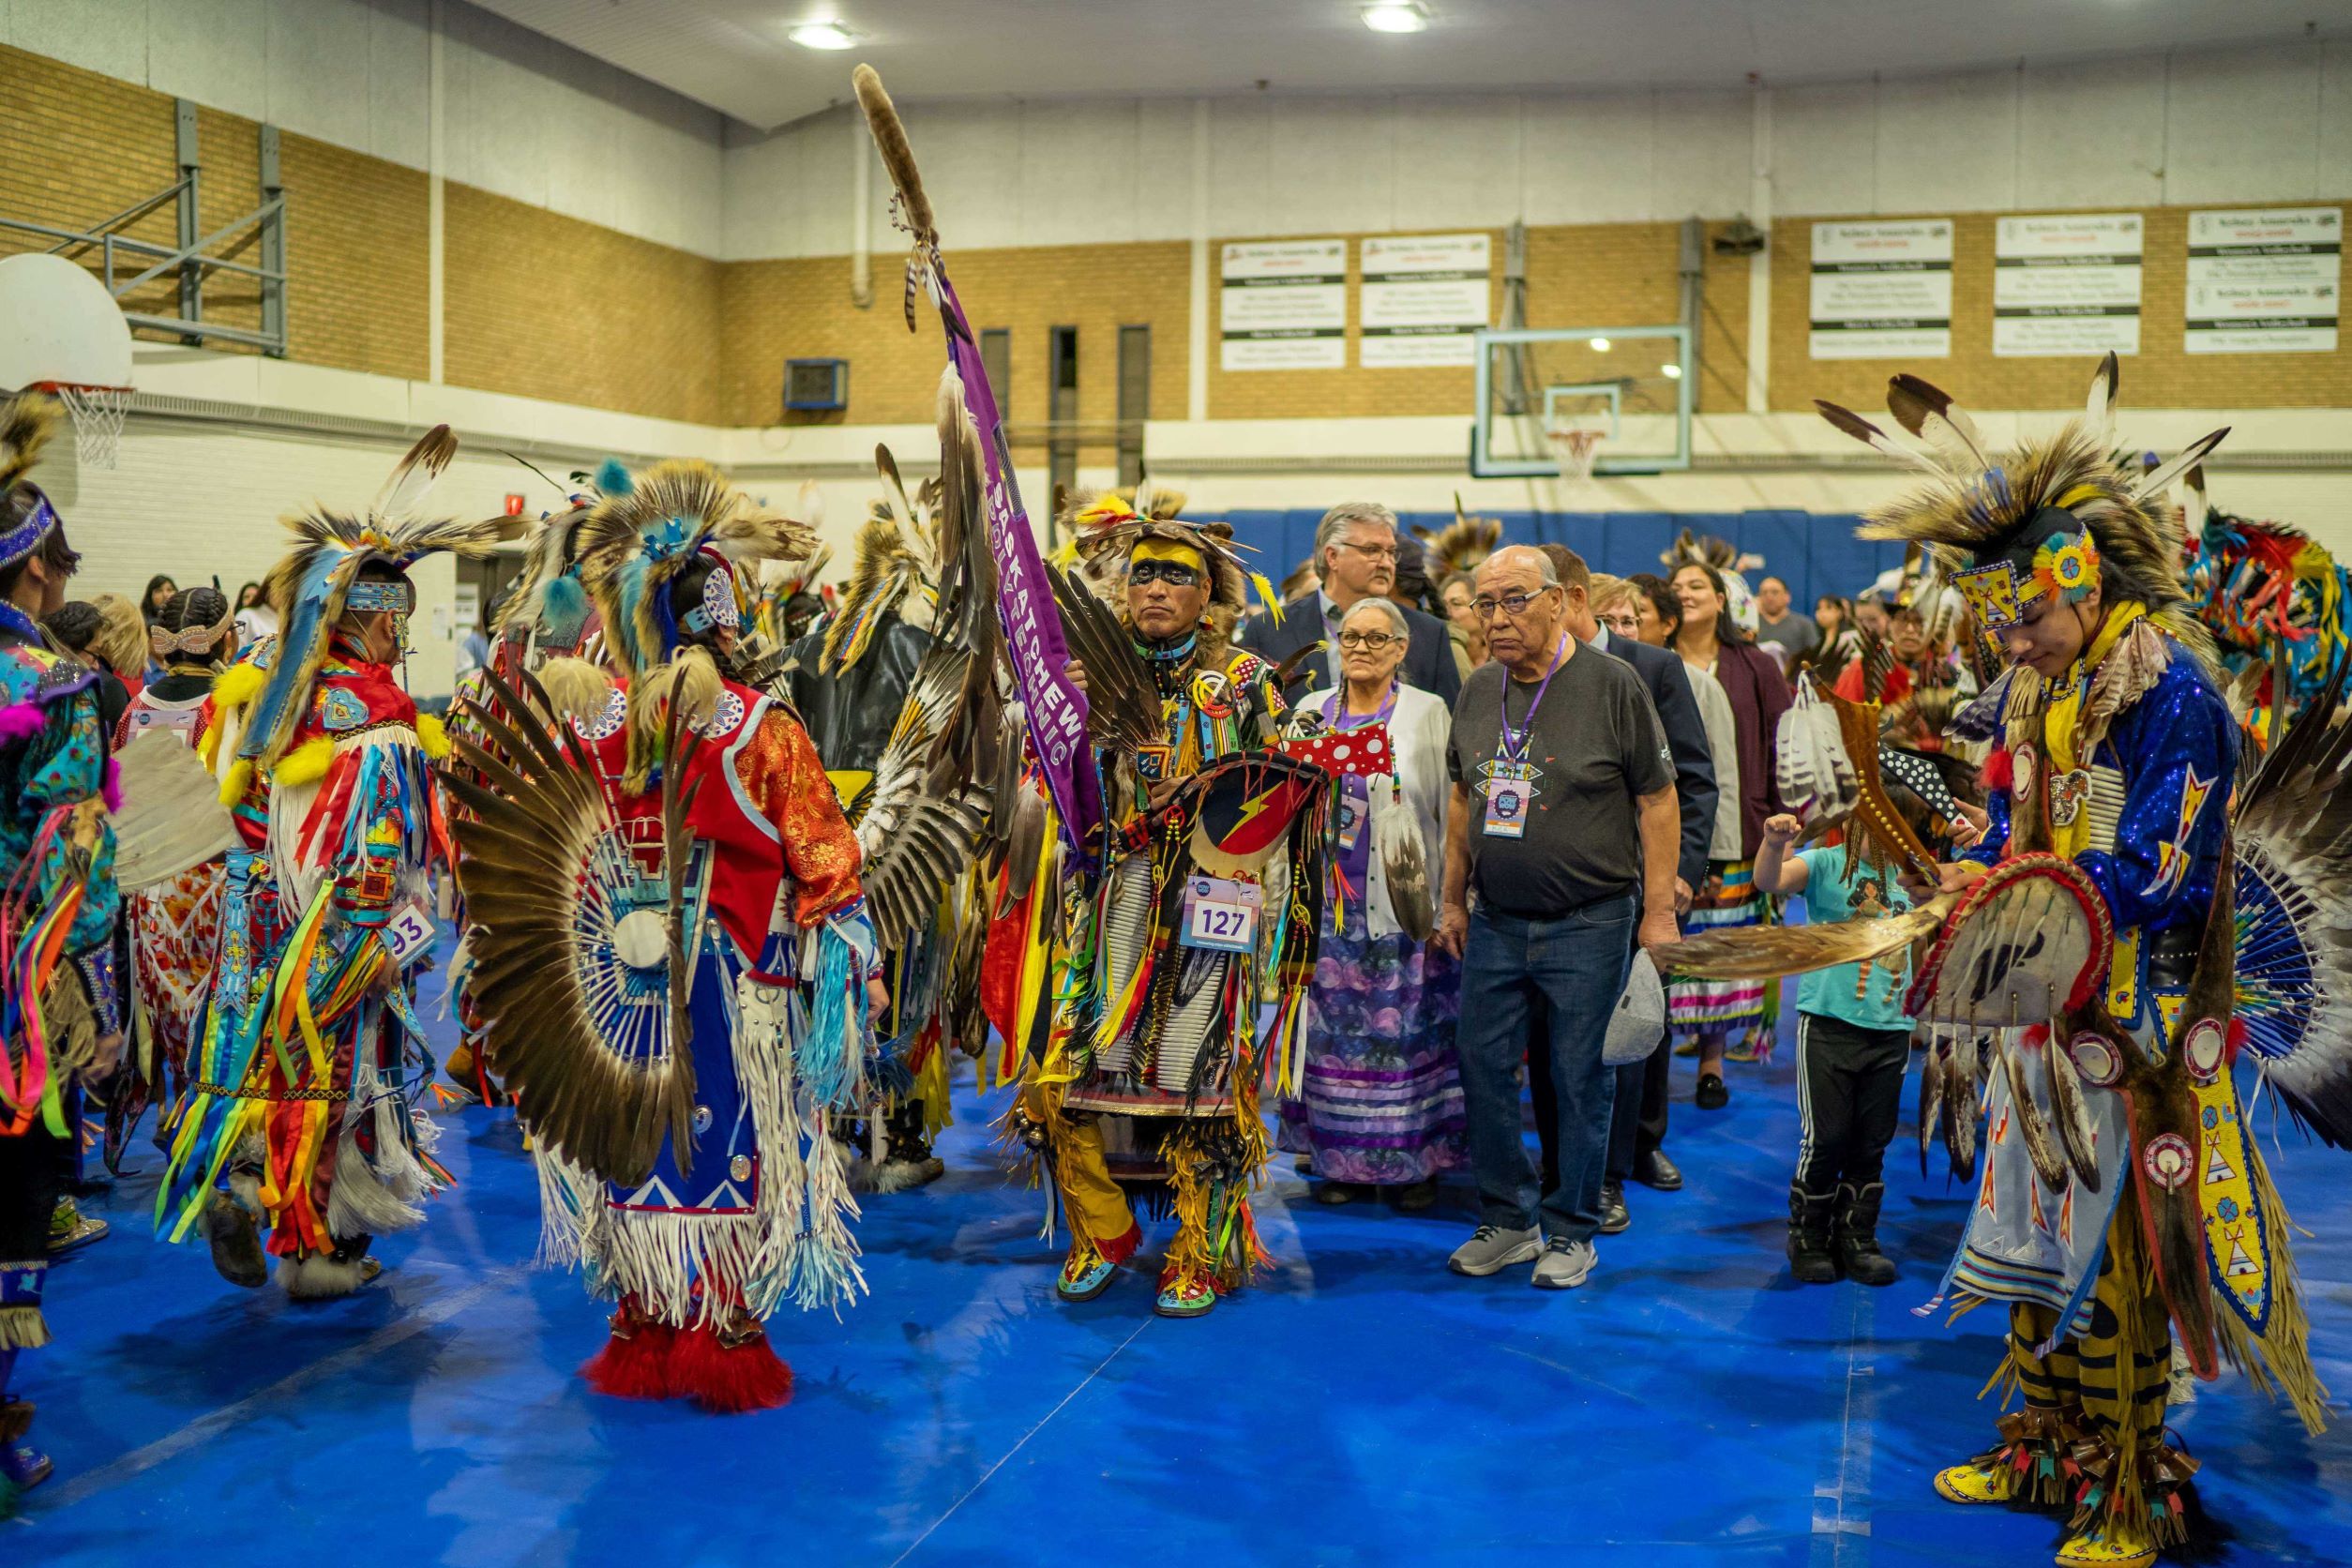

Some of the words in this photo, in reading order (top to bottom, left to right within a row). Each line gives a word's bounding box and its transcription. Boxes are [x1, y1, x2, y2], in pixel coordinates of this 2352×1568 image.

[987, 494, 1067, 766] POLYTECHNIC
[392, 915, 423, 956] 93
[1202, 909, 1245, 937] 127
